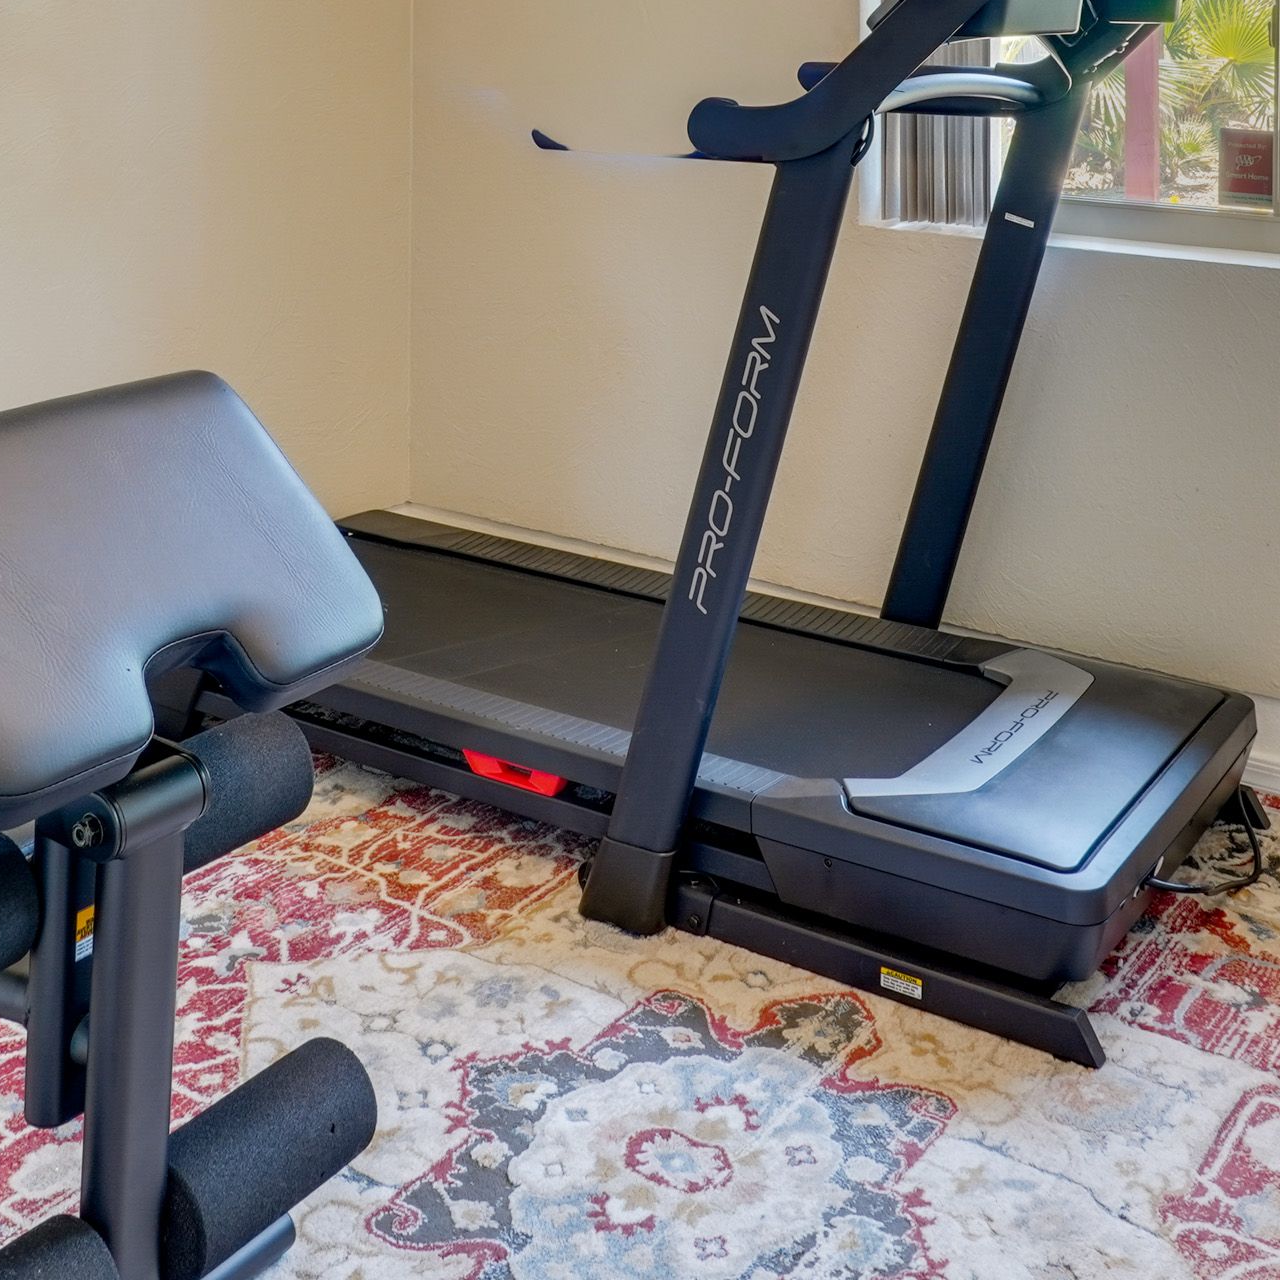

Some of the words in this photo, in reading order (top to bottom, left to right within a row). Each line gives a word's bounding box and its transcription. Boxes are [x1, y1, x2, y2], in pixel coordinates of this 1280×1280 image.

[1226, 171, 1247, 180] Smart
[1248, 173, 1269, 181] Home
[689, 305, 781, 615] PRO-FORM
[969, 689, 1059, 765] PRO-FORM
